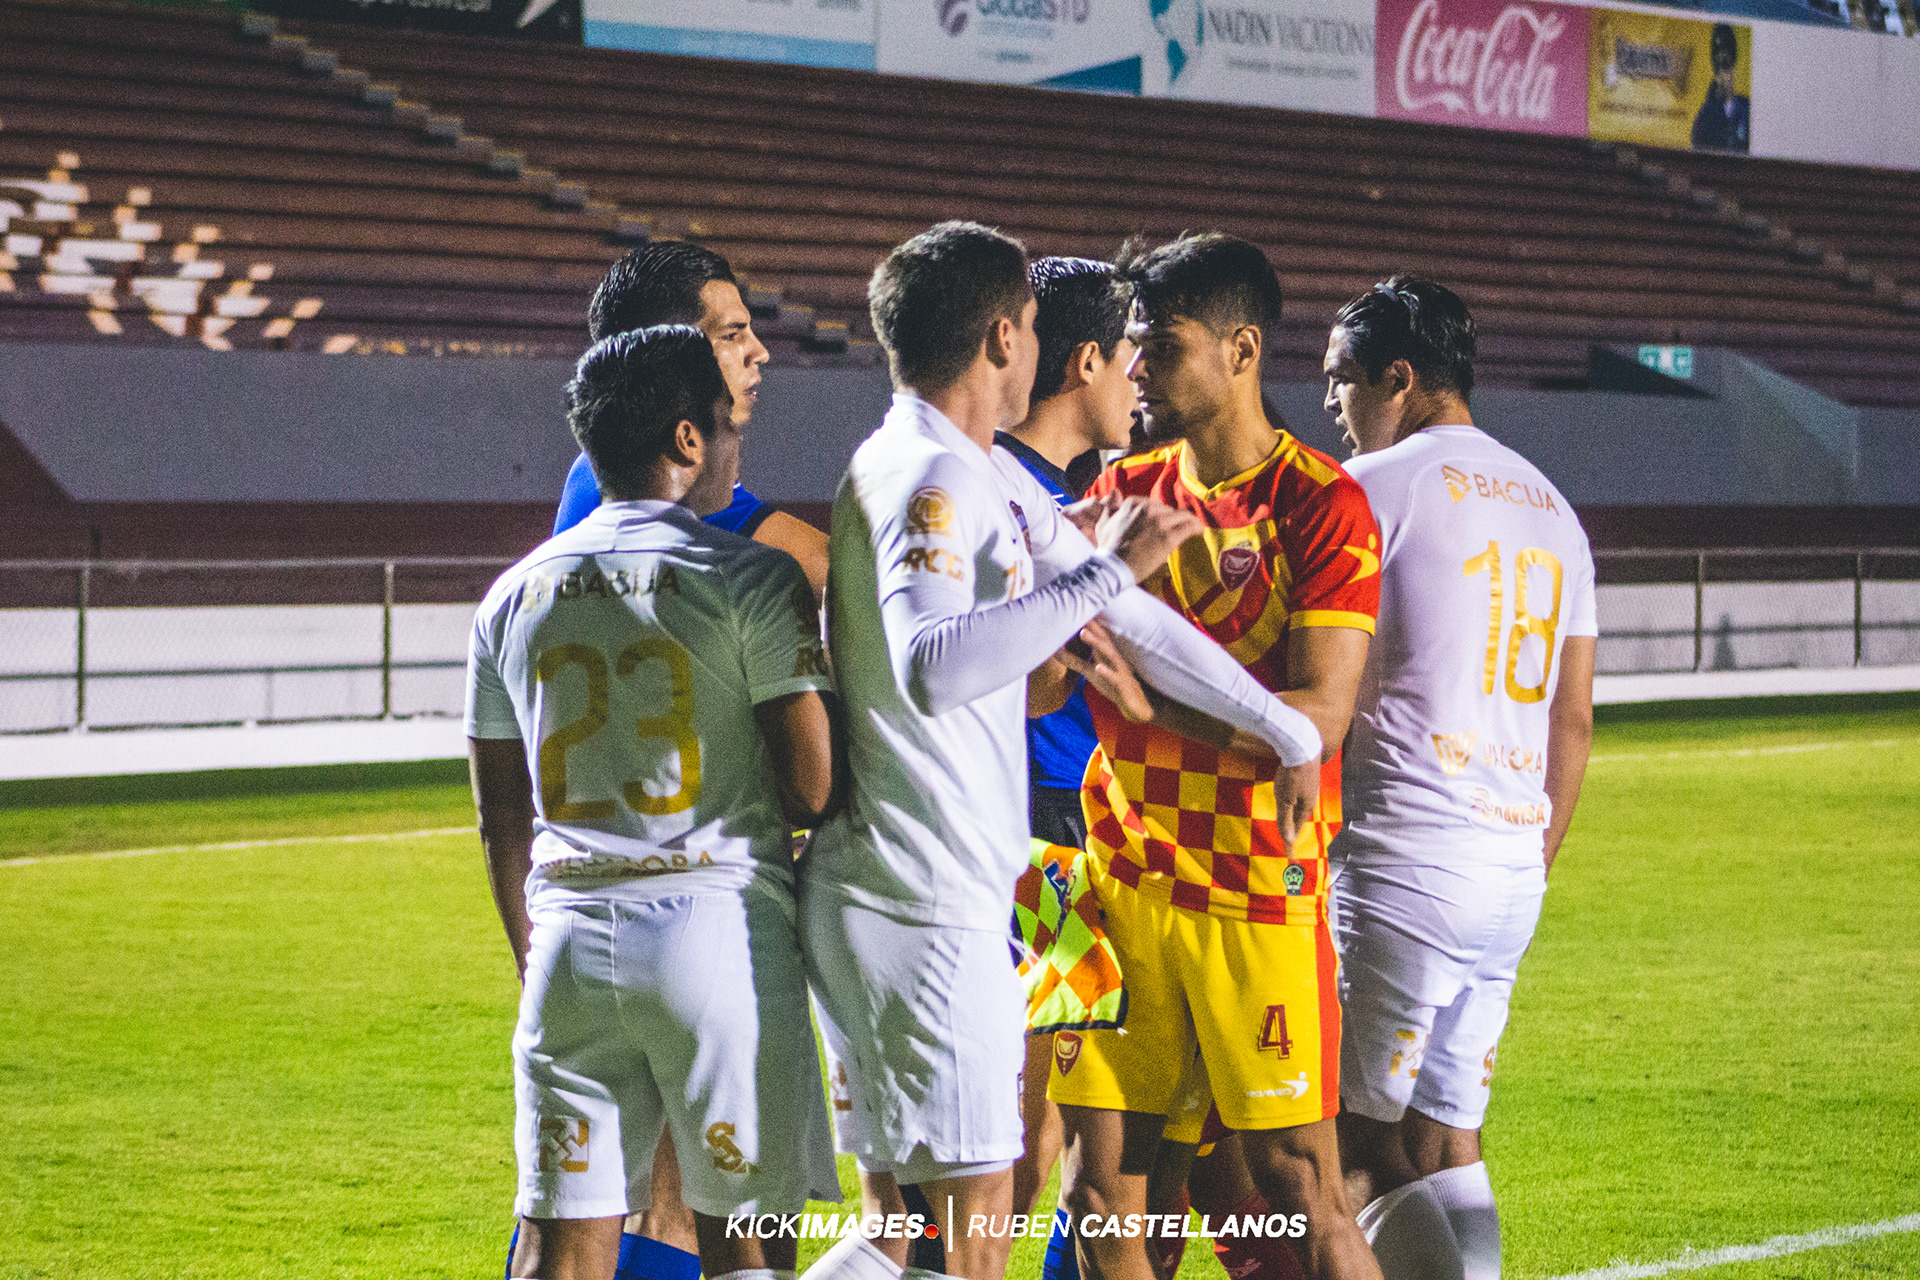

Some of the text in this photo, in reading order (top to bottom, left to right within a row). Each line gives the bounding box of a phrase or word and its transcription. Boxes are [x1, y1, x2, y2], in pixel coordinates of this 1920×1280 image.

[1463, 540, 1564, 704] 18
[537, 637, 702, 822] 23
[1256, 1004, 1294, 1060] 4
